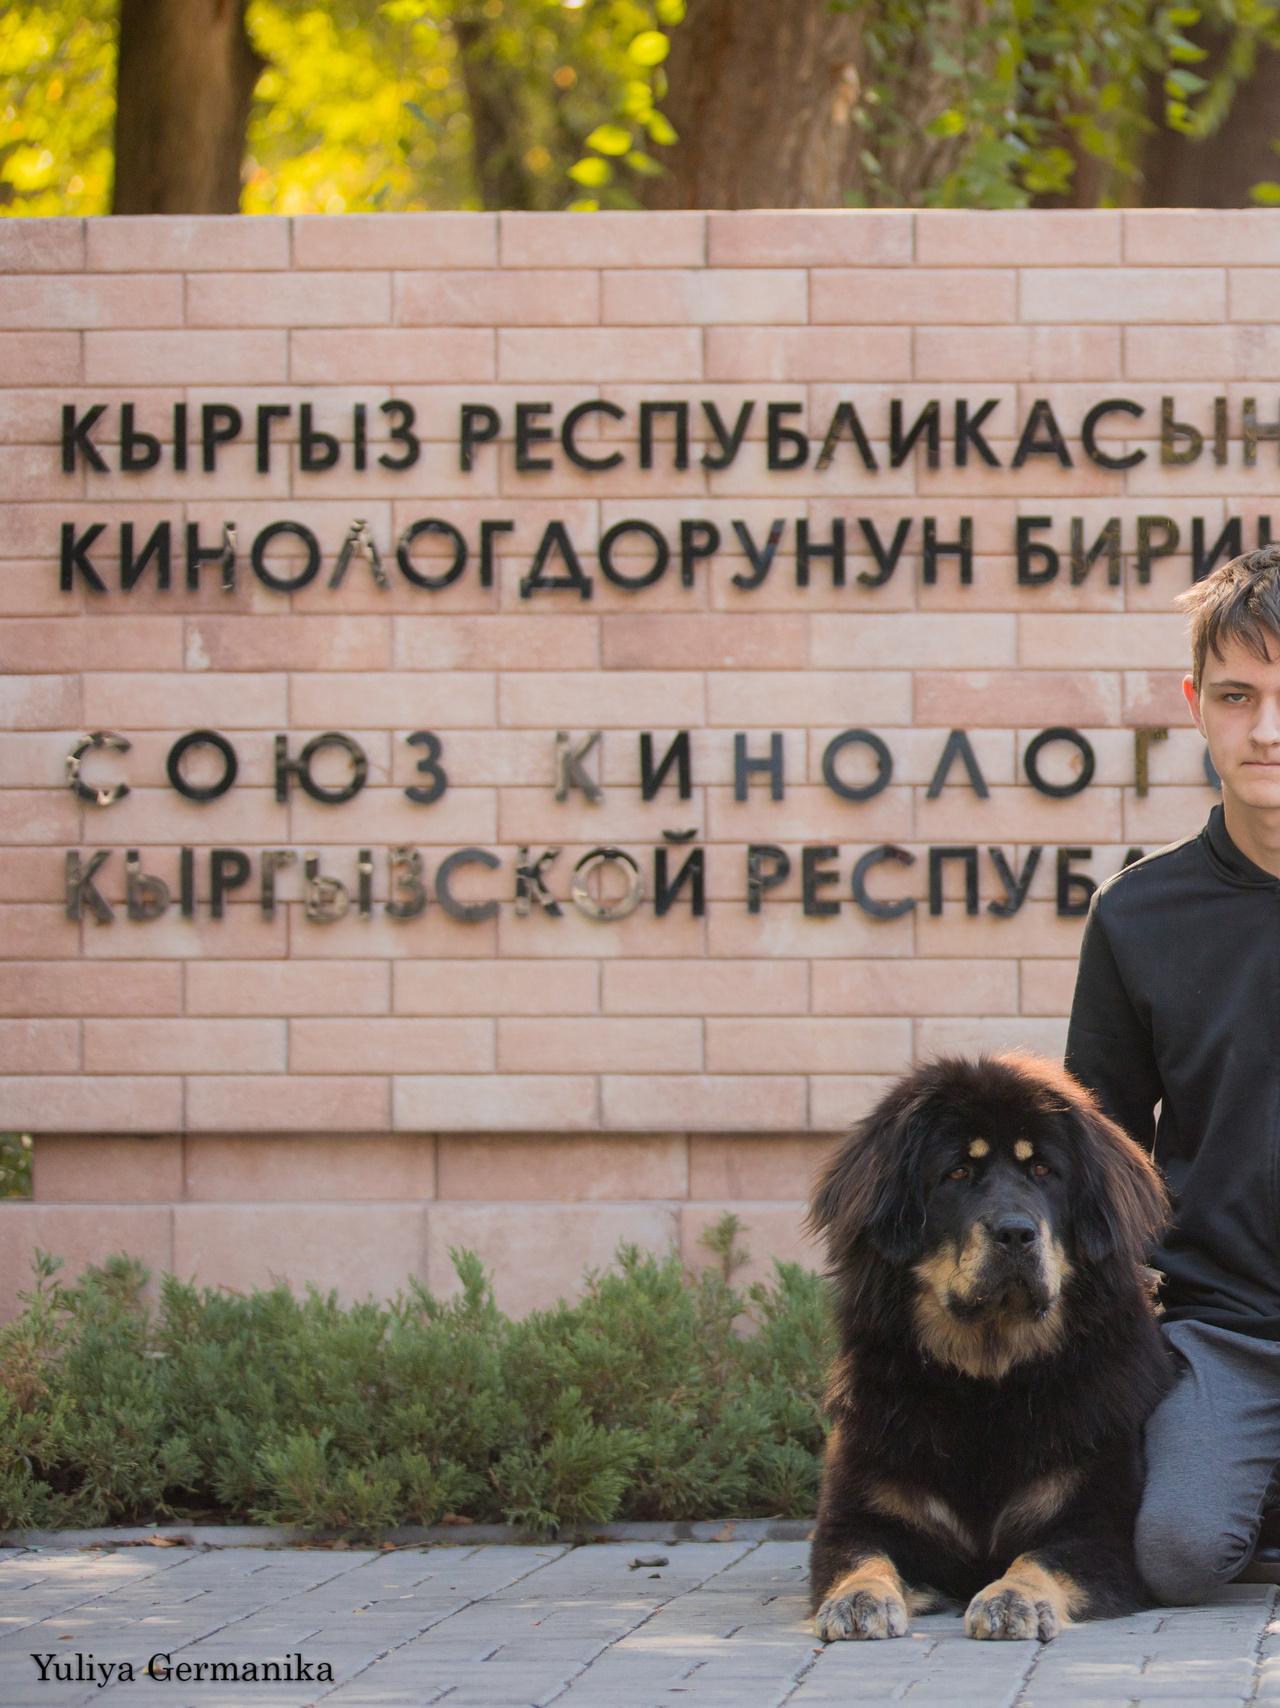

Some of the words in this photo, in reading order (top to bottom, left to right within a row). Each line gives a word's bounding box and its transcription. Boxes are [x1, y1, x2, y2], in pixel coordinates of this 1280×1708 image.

[60, 399, 421, 474] КЫРГЫЗ
[59, 516, 974, 600] КИНОЛОГДОРУНУН
[66, 729, 449, 806] СОЮЗ
[64, 827, 707, 922] КЫРГЫЗСКОЙ
[746, 844, 1146, 919] РЕСПУБ
